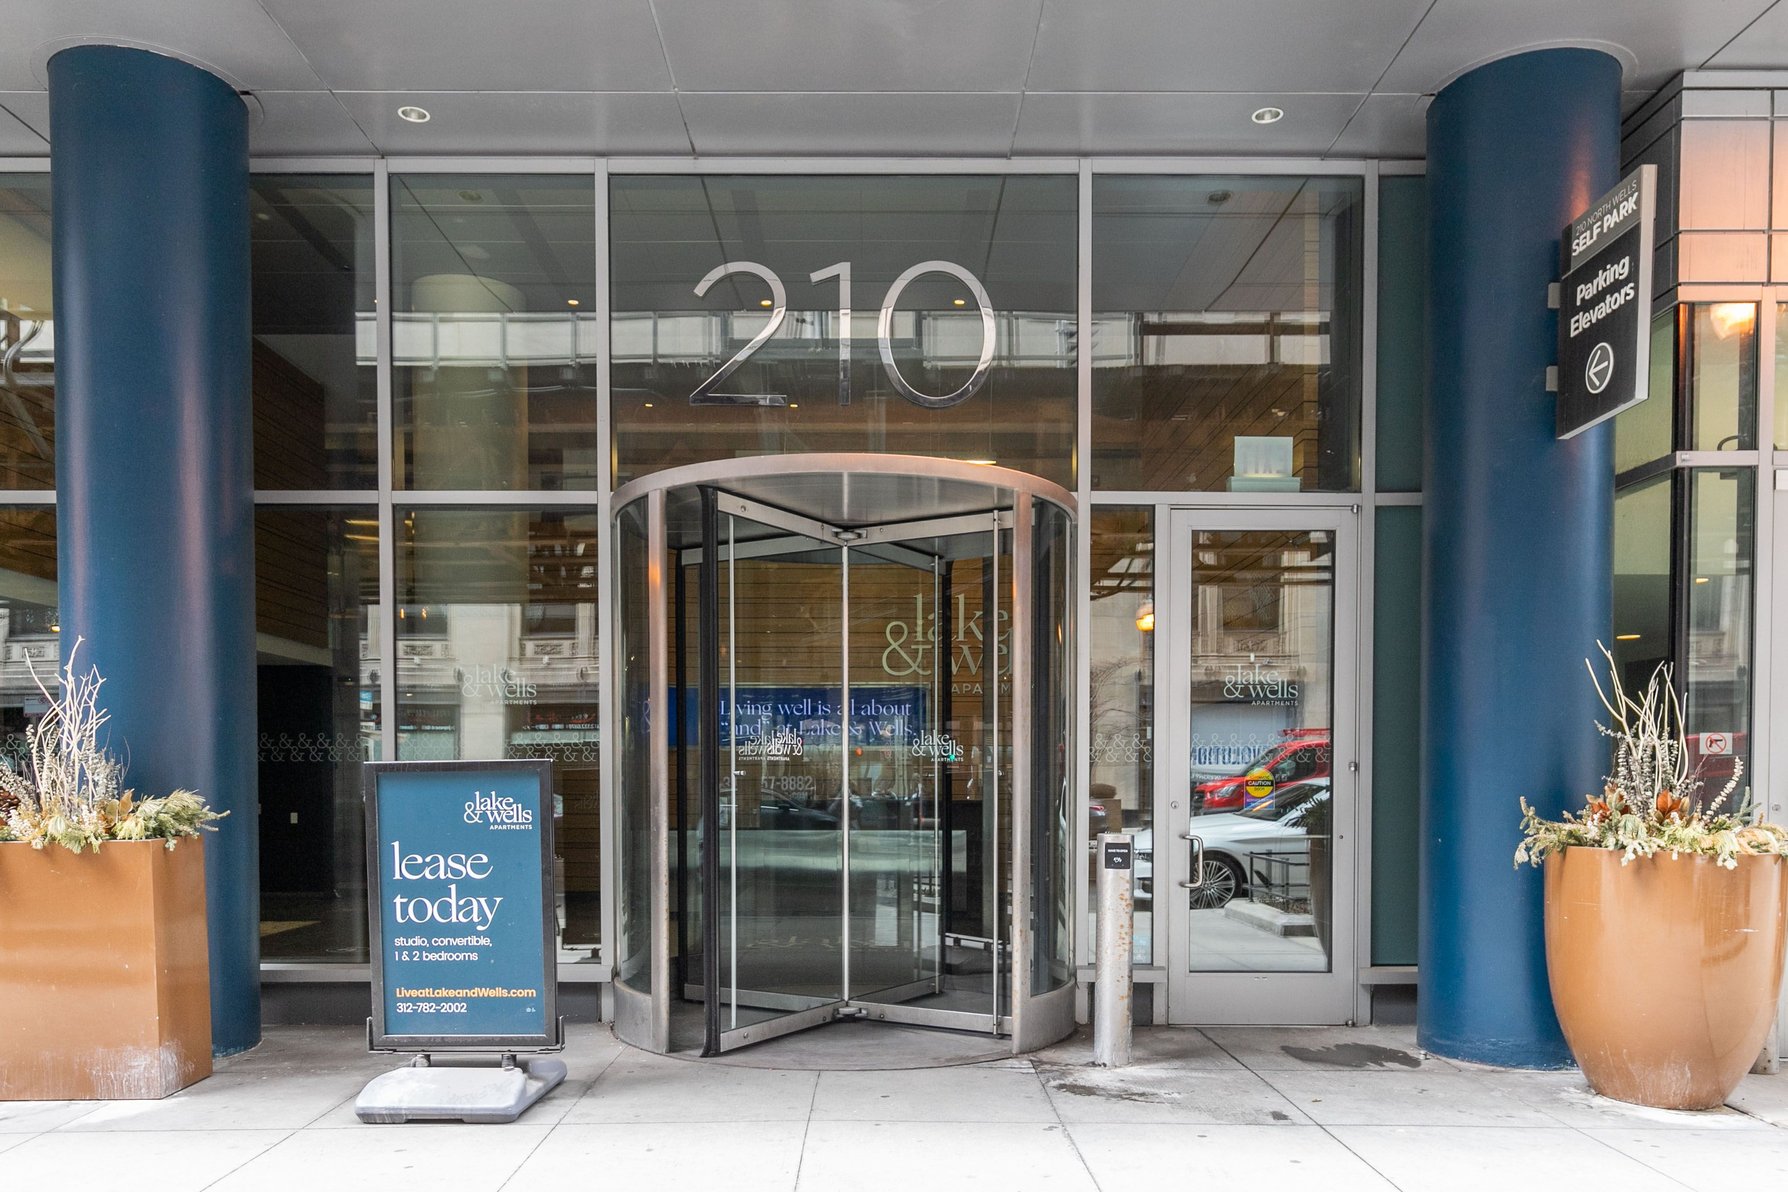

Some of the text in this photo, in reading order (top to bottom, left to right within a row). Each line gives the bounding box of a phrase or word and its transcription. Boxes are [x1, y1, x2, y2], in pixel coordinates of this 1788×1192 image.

[1576, 179, 1637, 237] 210 NORTH WELLS
[1572, 191, 1639, 257] SELF PARK
[1576, 255, 1630, 307] Parking
[1570, 282, 1635, 338] Elevators
[689, 259, 997, 410] 210
[881, 620, 932, 676] &
[474, 663, 517, 684] lake
[1236, 664, 1280, 685] lake
[461, 674, 538, 698] & wells
[1223, 674, 1299, 699] & wells
[720, 699, 912, 721] Lving well is al about
[799, 720, 841, 736] Lake
[868, 719, 917, 736] Wells.
[921, 729, 950, 746] lake
[911, 738, 964, 757] & wells
[474, 790, 514, 811] lake
[463, 801, 533, 824] & wells
[391, 840, 494, 881] lease
[393, 883, 504, 931] today
[394, 935, 493, 948] studio, convertible,
[401, 951, 410, 961] &
[412, 951, 420, 961] 2
[422, 950, 479, 961] bedrooms
[395, 987, 537, 998] LiveatLakeandWells.com
[396, 1002, 468, 1014] 312-782-2002
